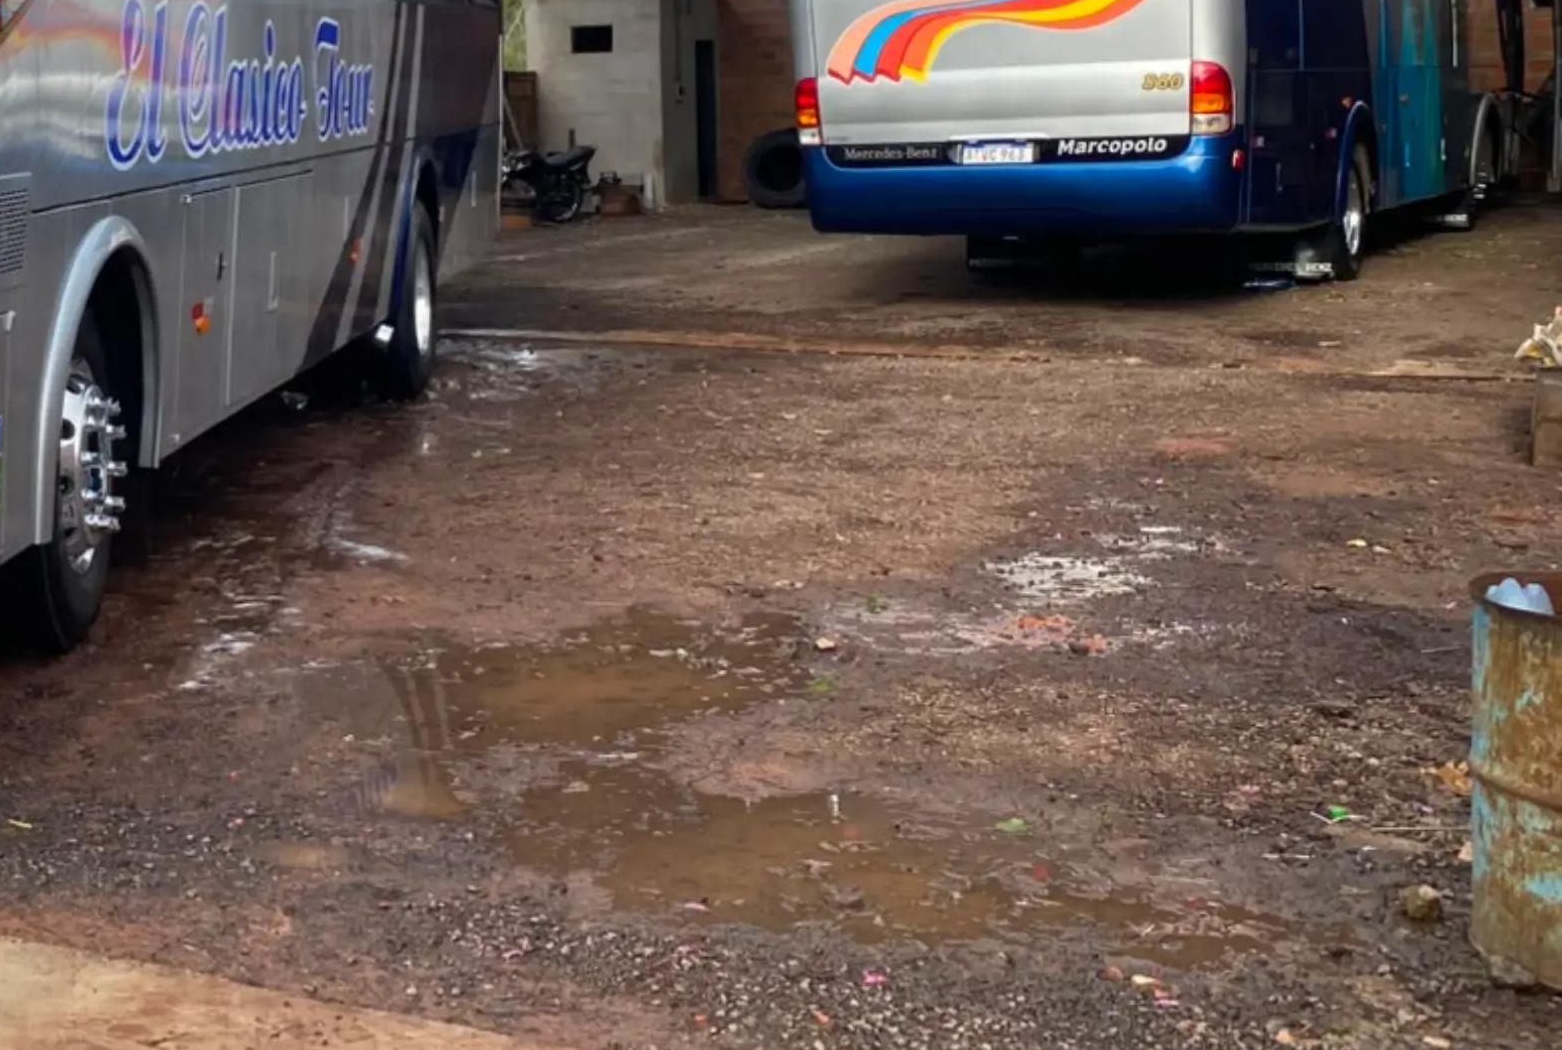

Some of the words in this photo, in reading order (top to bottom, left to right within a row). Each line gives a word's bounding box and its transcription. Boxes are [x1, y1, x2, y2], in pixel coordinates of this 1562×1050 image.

[179, 0, 307, 158] Clasico
[313, 16, 375, 143] Tour
[1057, 137, 1167, 155] Marcopolo
